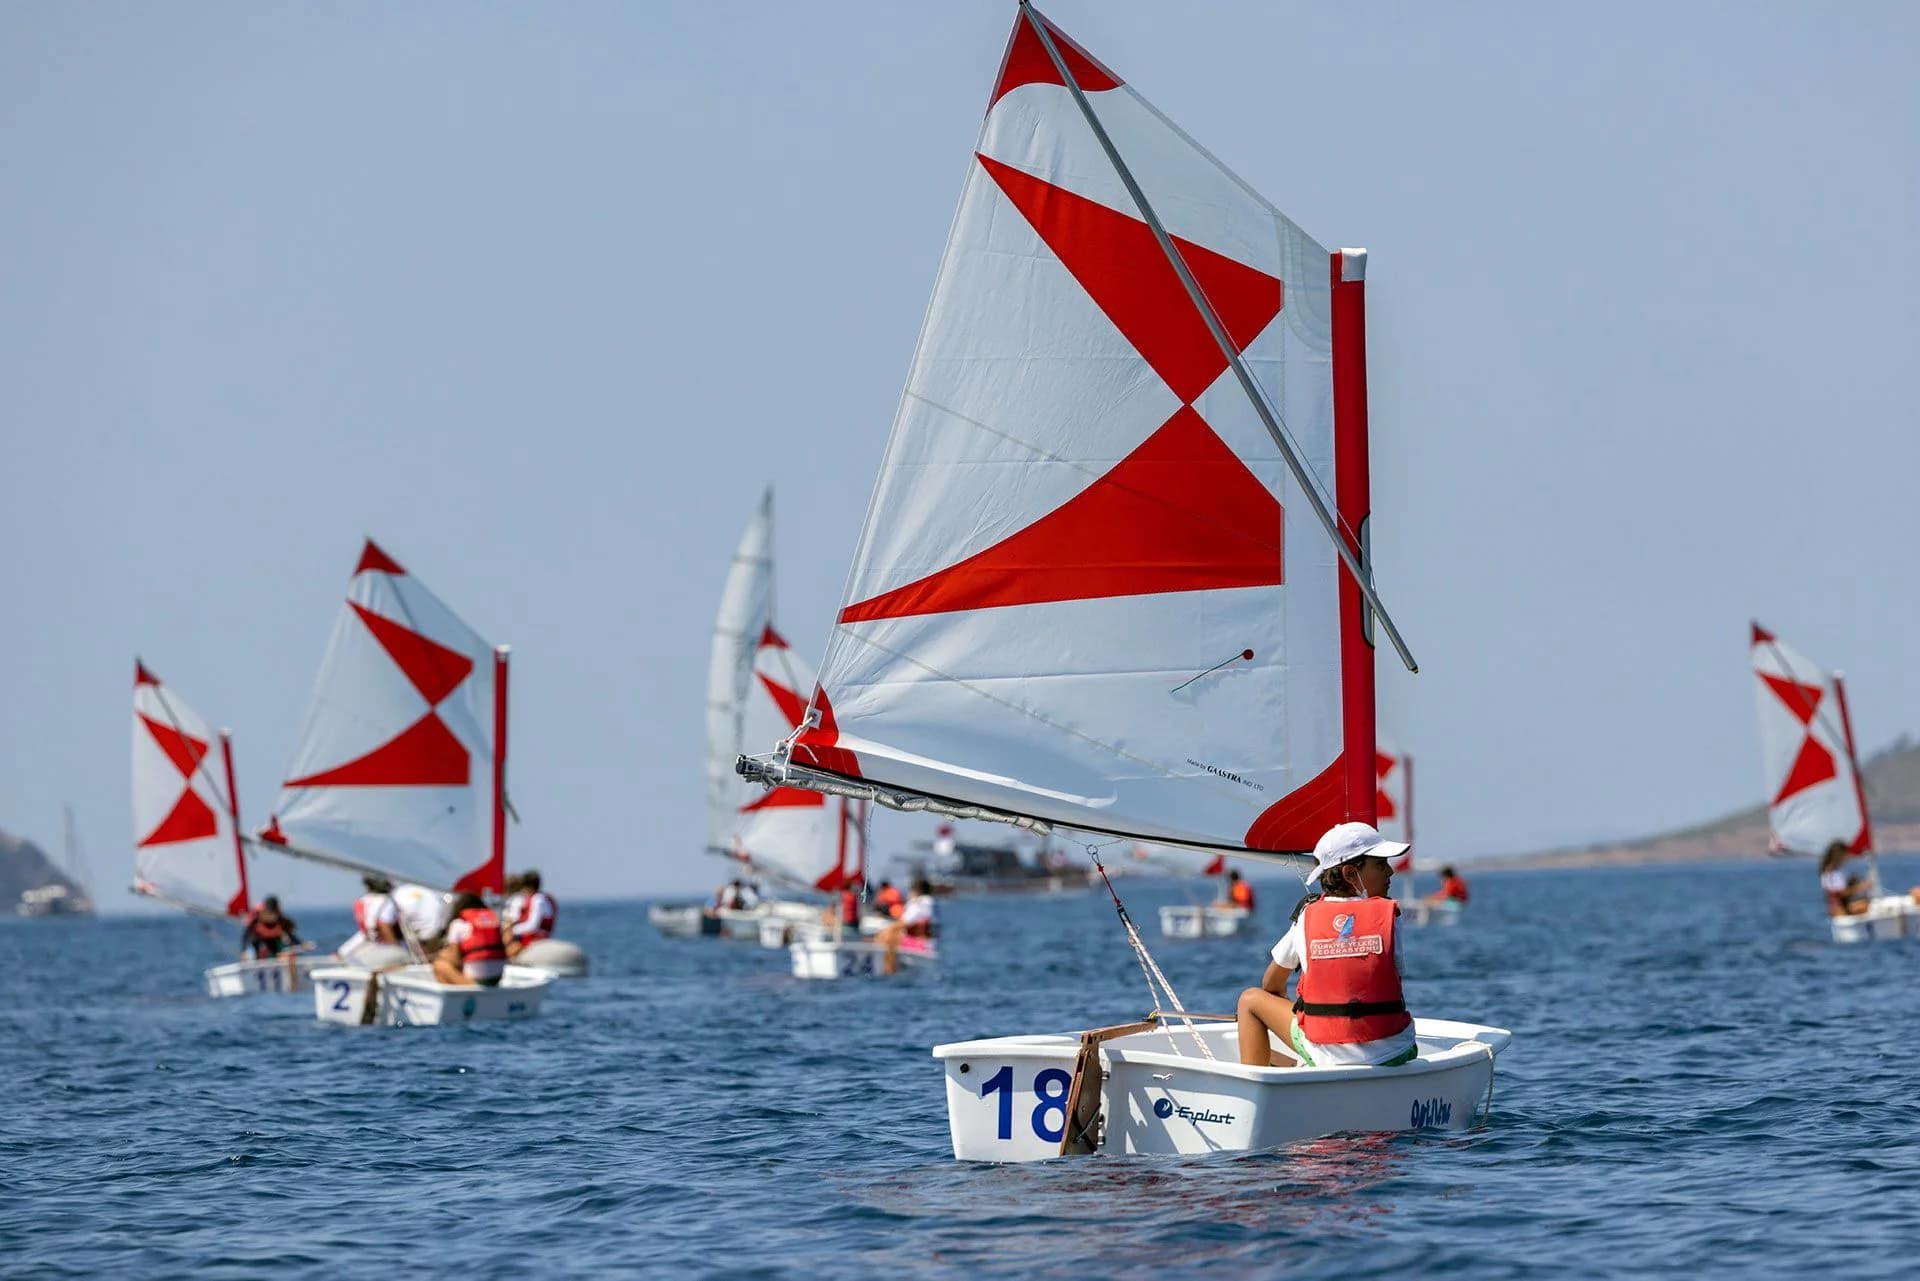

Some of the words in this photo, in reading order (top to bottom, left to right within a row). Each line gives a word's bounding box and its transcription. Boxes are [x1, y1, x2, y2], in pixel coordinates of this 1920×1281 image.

[1207, 765, 1241, 783] GAASTRA
[333, 981, 351, 1012] 2
[981, 1065, 1072, 1143] 18
